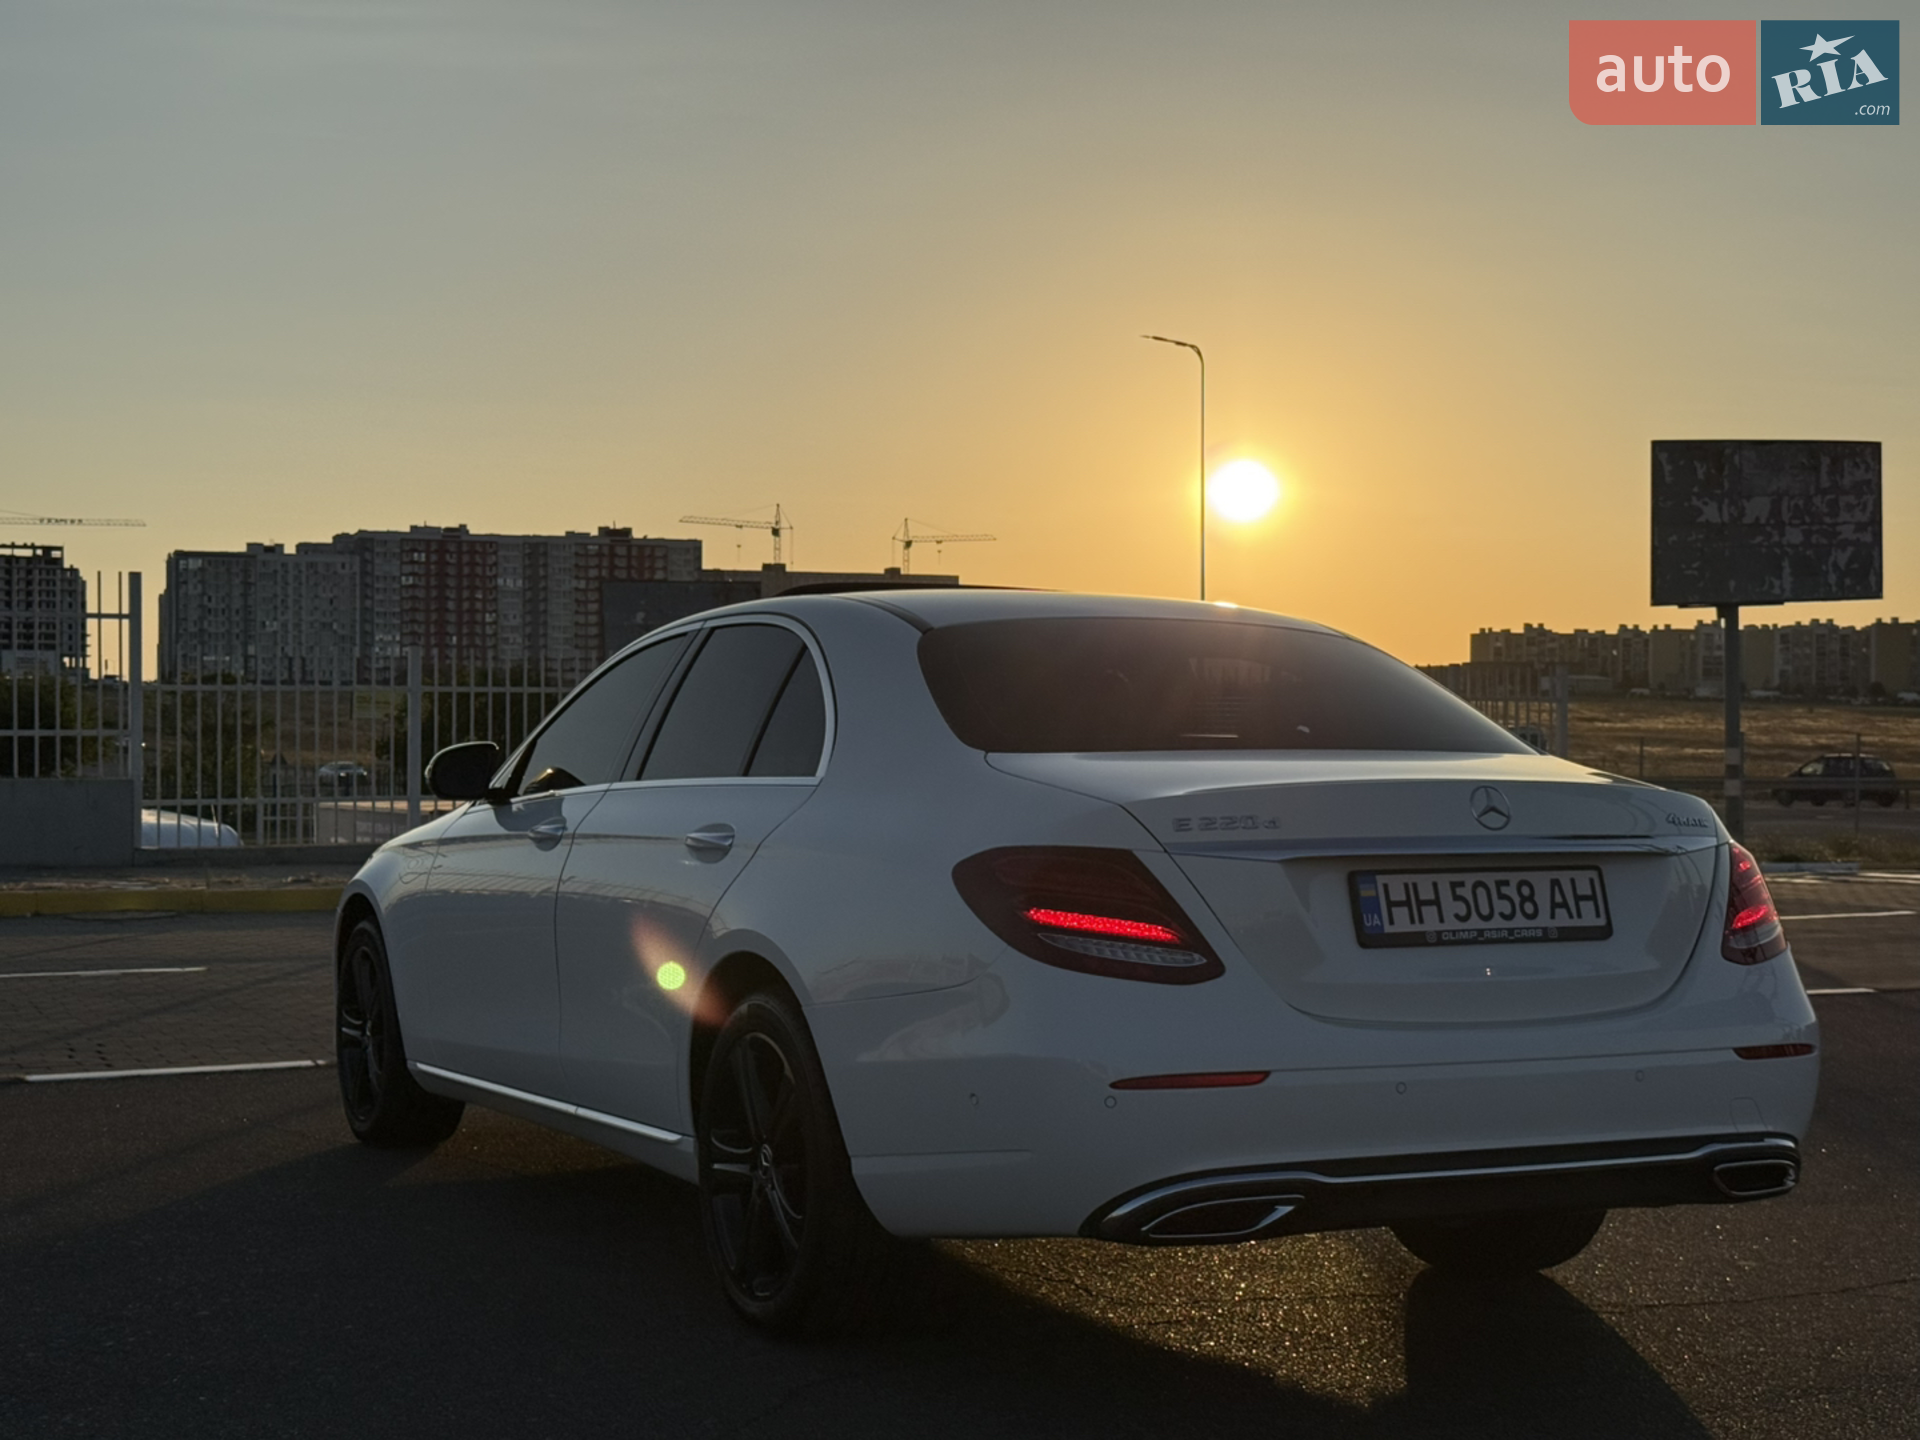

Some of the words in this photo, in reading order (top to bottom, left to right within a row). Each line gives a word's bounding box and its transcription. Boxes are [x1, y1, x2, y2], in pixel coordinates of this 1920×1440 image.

[1173, 818, 1193, 833] E
[1198, 815, 1259, 832] 220
[1382, 880, 1445, 926] HH
[1449, 878, 1540, 923] 5058
[1549, 876, 1602, 920] AH
[1363, 913, 1382, 928] UA
